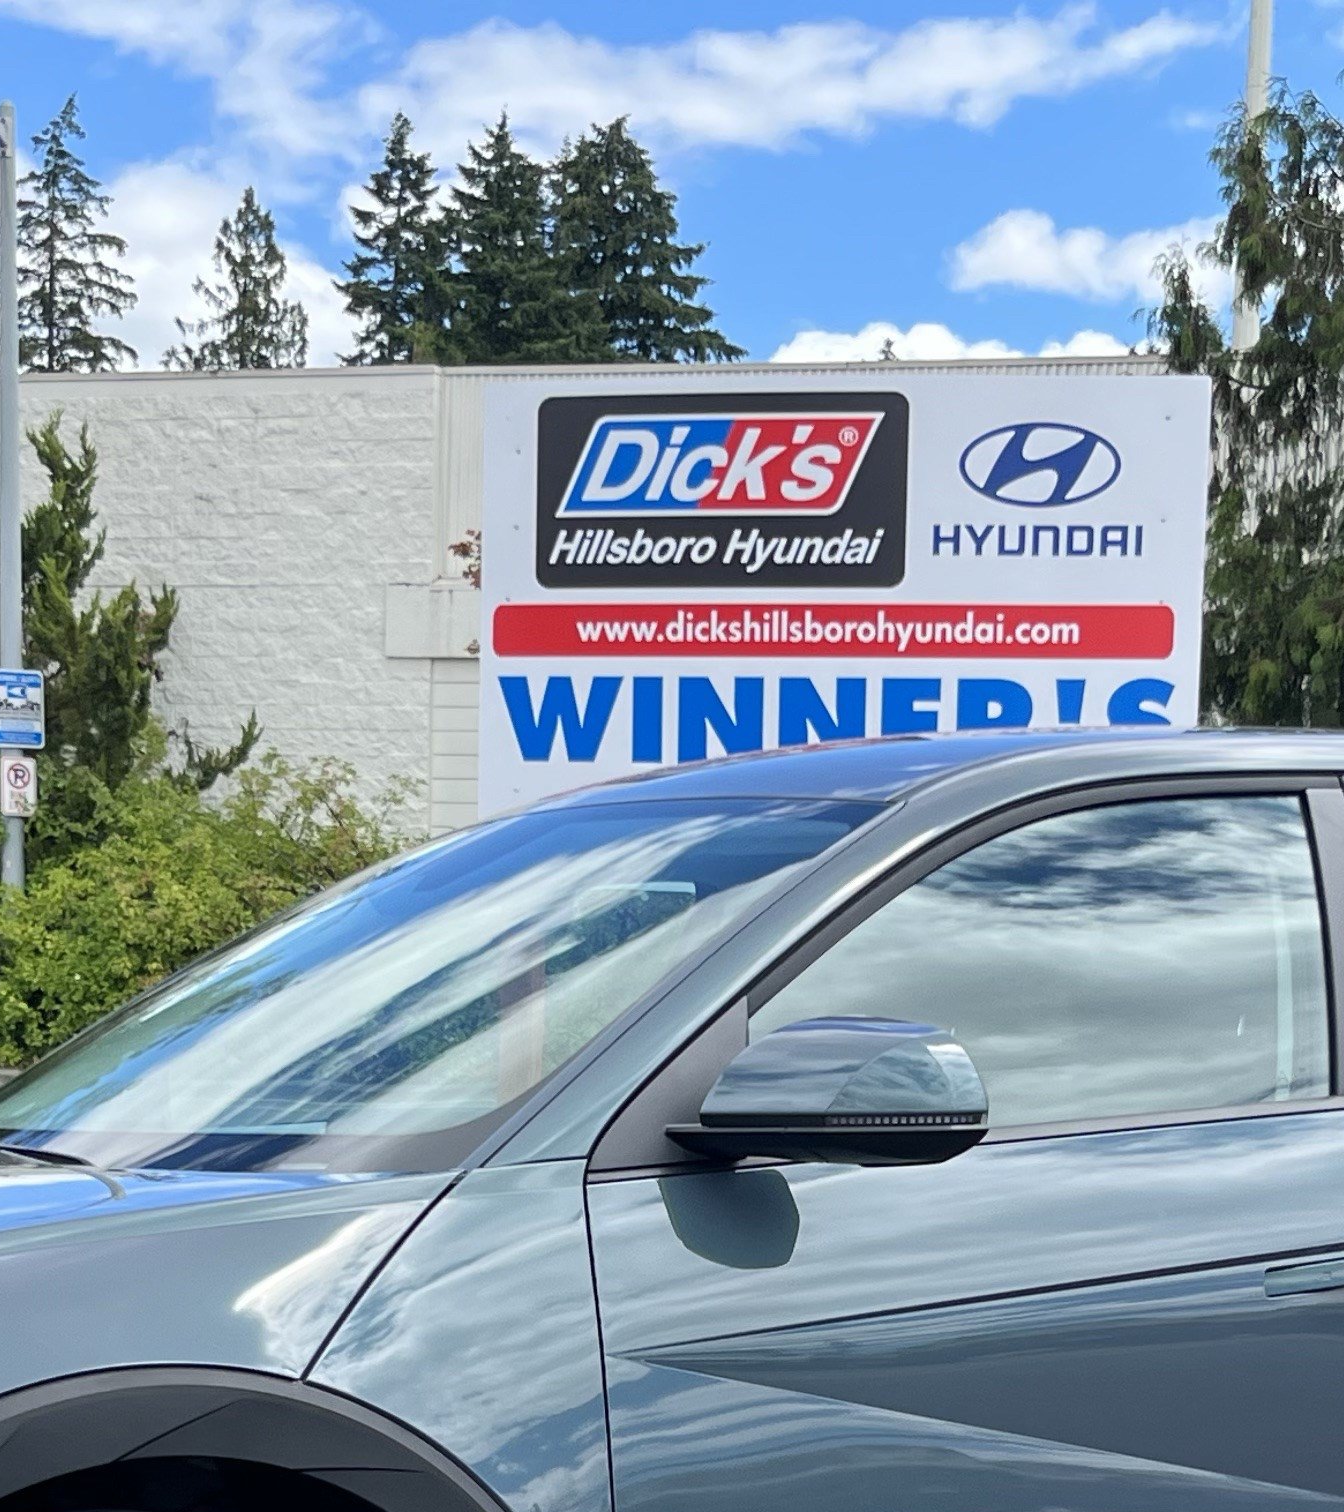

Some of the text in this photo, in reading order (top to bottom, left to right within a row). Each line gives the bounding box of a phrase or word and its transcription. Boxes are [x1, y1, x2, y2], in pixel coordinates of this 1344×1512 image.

[580, 425, 842, 503] Dick's
[548, 528, 885, 574] Hillsboro Hyundai
[932, 524, 1144, 558] HYUNDAI
[575, 609, 1080, 653] www.dickshillsborohyundai.com
